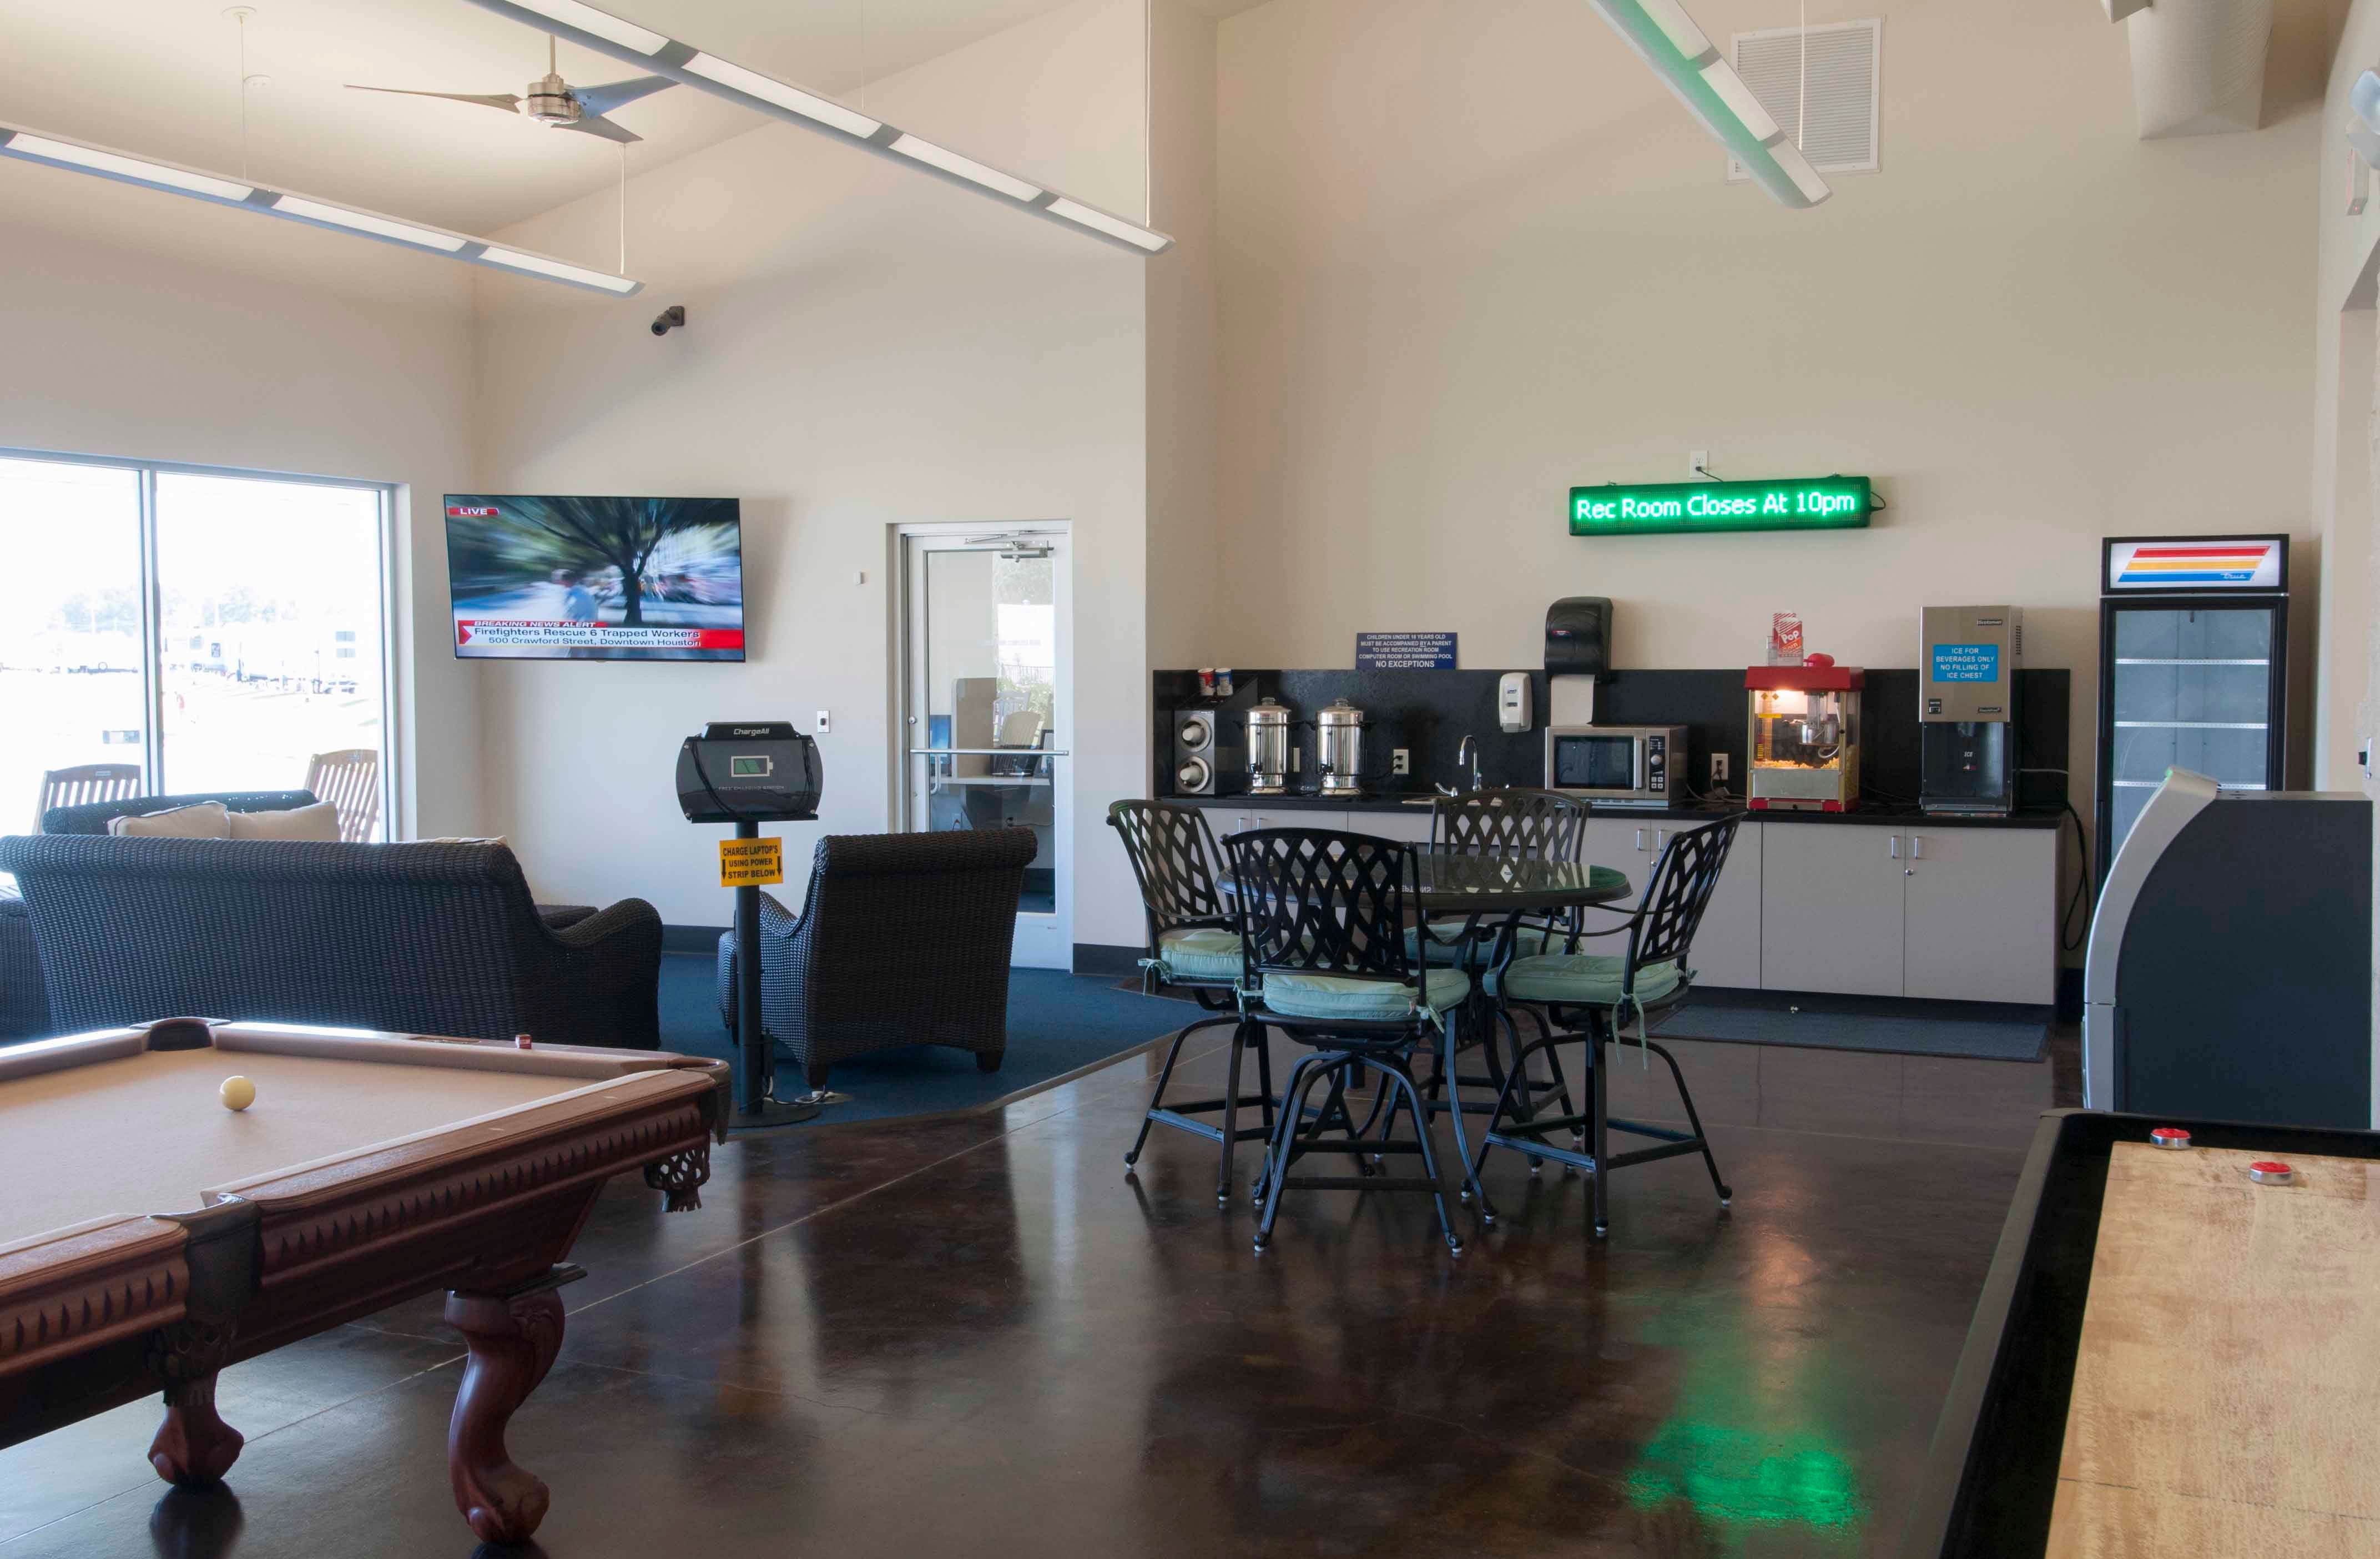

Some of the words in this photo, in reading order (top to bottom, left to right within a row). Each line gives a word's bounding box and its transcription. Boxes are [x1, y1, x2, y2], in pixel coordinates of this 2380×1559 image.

[1576, 499, 1616, 520] Rec
[1622, 498, 1681, 518] Room
[1687, 494, 1756, 516] Closes
[1763, 493, 1787, 514] At
[1797, 491, 1855, 516] 10pm
[475, 628, 540, 636] Firefighters
[544, 628, 586, 636] Rescue
[601, 629, 648, 638] Trapped
[652, 630, 699, 638] Workers
[733, 728, 770, 736] ChargeAll
[723, 847, 749, 856] CHARGE
[750, 844, 778, 855] LAPTOP'S
[729, 859, 749, 867] USING
[750, 857, 773, 867] POWER
[728, 870, 749, 879] STRIP
[750, 869, 776, 878] BELOW
